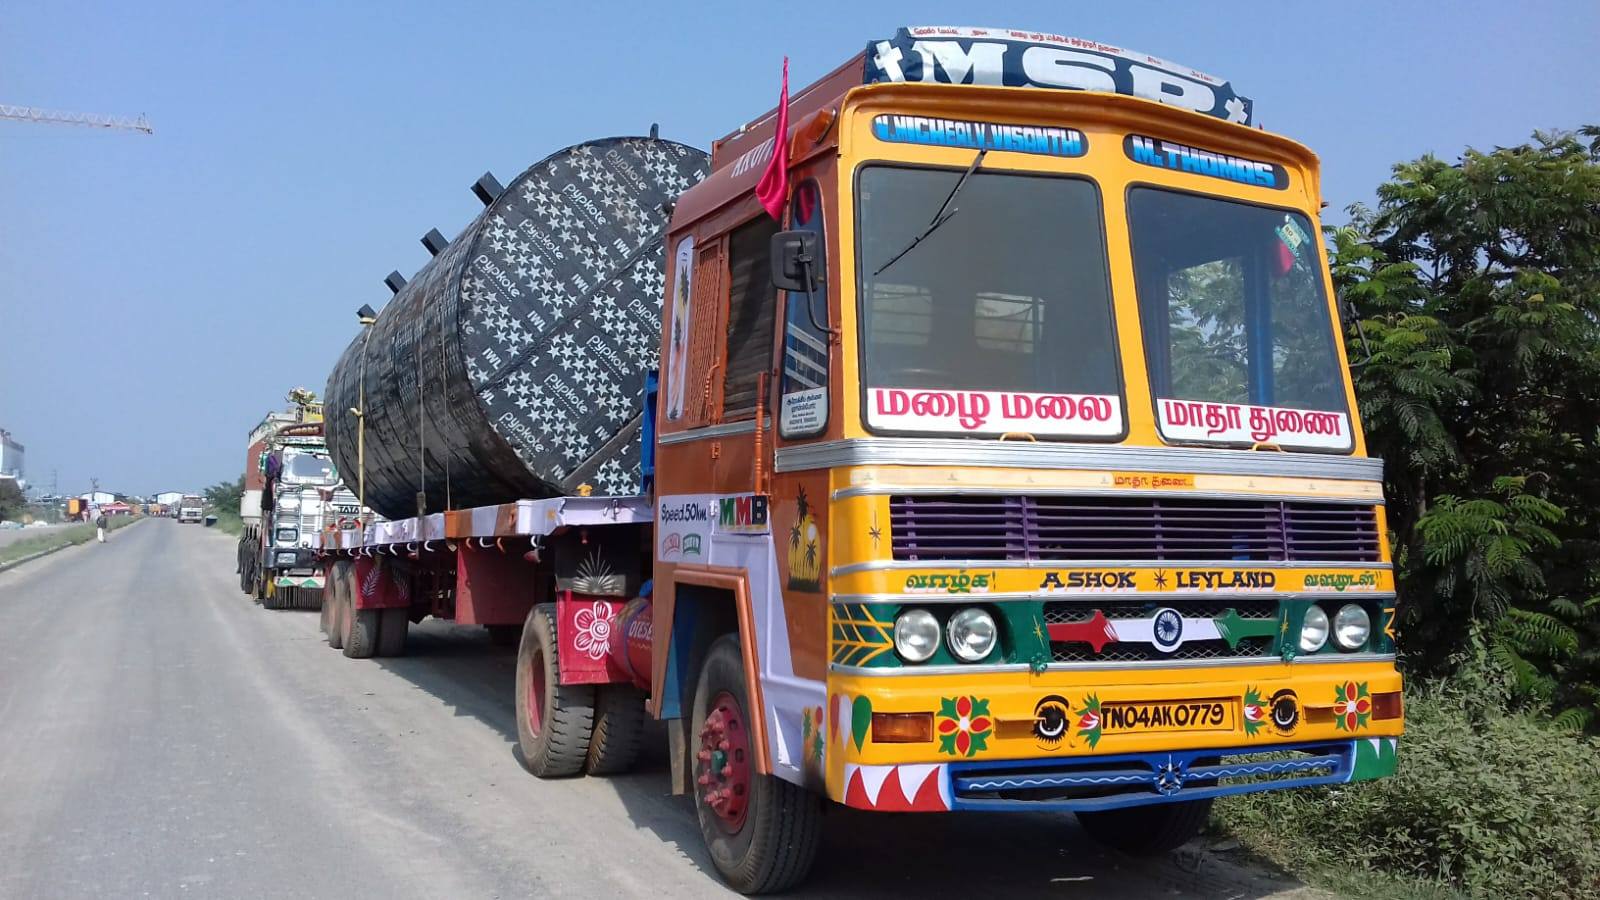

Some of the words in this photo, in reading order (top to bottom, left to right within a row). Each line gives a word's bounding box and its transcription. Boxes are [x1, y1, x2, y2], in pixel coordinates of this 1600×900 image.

[562, 183, 606, 225] pypkote
[613, 238, 631, 259] IWL
[473, 255, 520, 297] pypkote
[571, 274, 589, 295] IWL
[527, 310, 546, 332] IWL
[482, 347, 501, 370] IWL
[586, 335, 630, 376] pypkote
[543, 373, 588, 415] pypkote
[876, 389, 991, 430] மழை
[1001, 393, 1113, 422] மலை
[499, 412, 544, 453] pypkote
[594, 425, 610, 441] IW
[1164, 401, 1242, 438] மாதா
[1249, 407, 1341, 442] துணை
[551, 464, 565, 480] IW
[719, 495, 768, 527] MMB
[1039, 571, 1137, 588] ASHOK
[1175, 571, 1277, 588] LEYLAND
